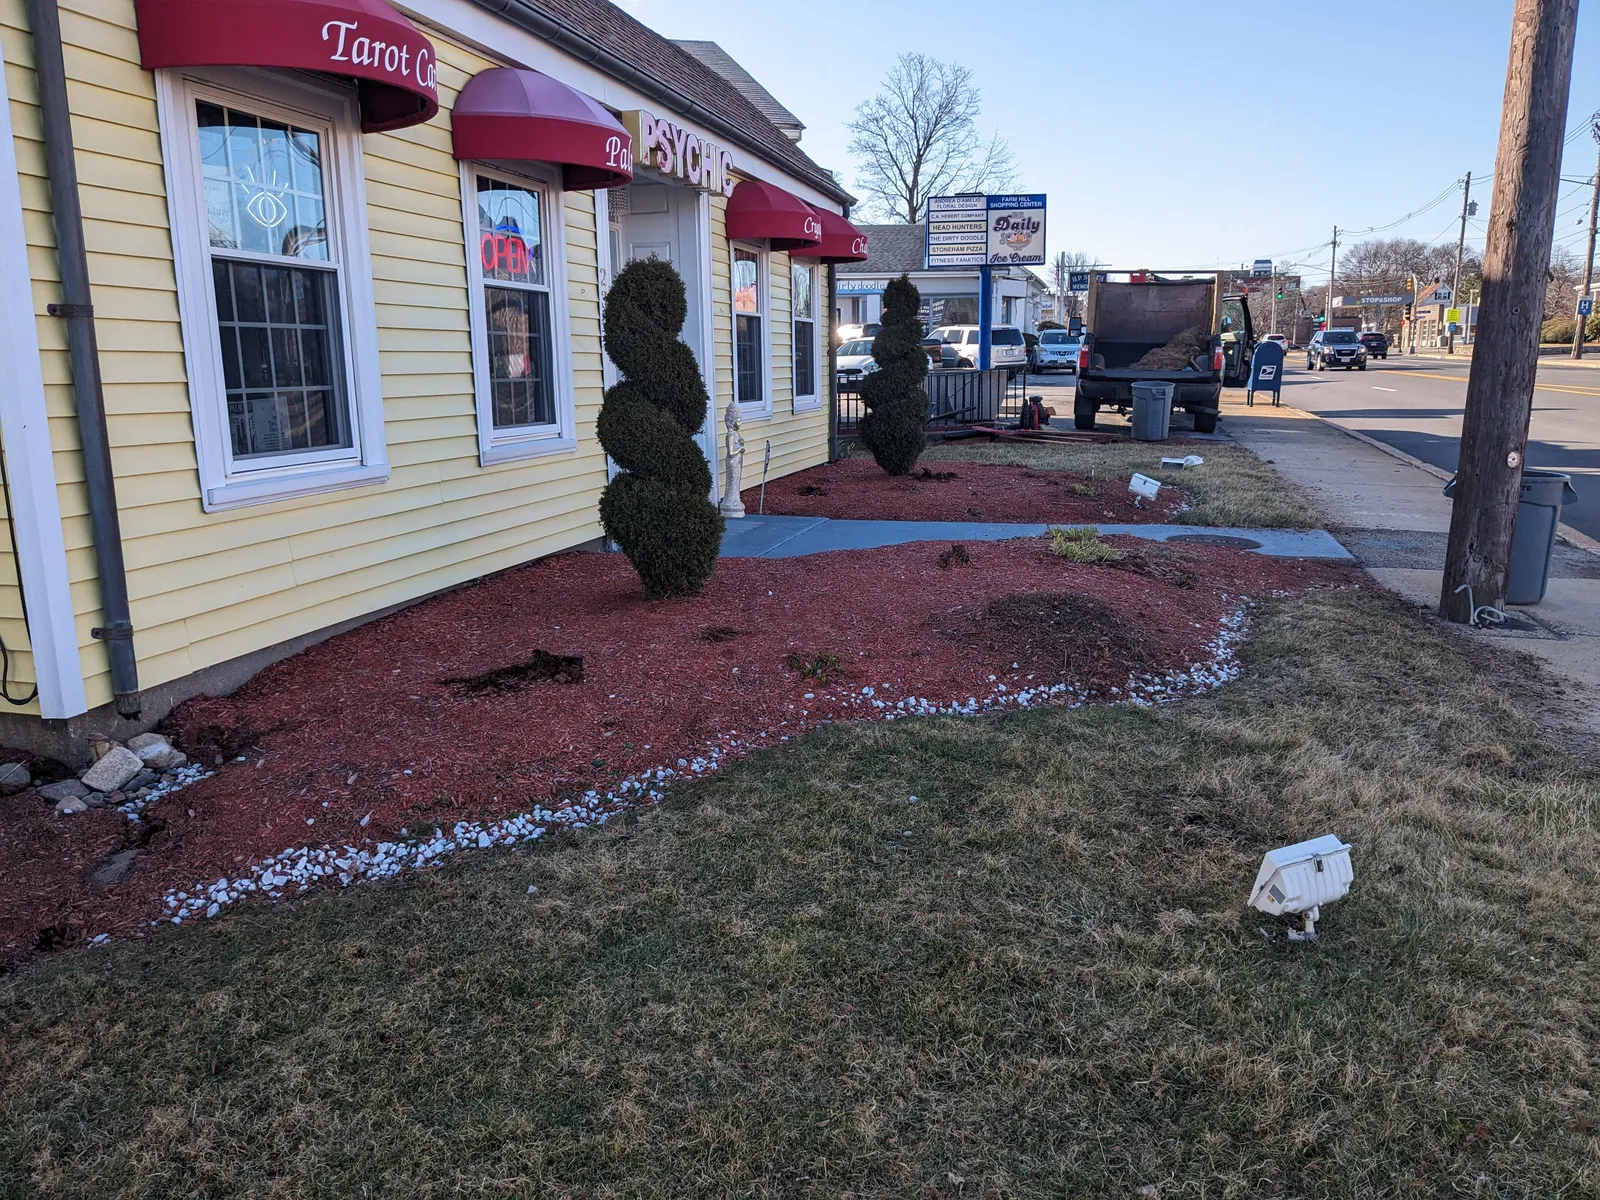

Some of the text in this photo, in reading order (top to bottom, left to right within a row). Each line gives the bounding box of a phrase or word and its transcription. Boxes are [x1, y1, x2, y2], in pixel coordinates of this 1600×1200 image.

[321, 20, 410, 76] Tarot
[640, 109, 734, 198] PSYCHIC
[993, 215, 1040, 234] Daily
[481, 232, 531, 275] OPEN
[989, 252, 1043, 263] Ice Cream
[1581, 301, 1589, 309] H
